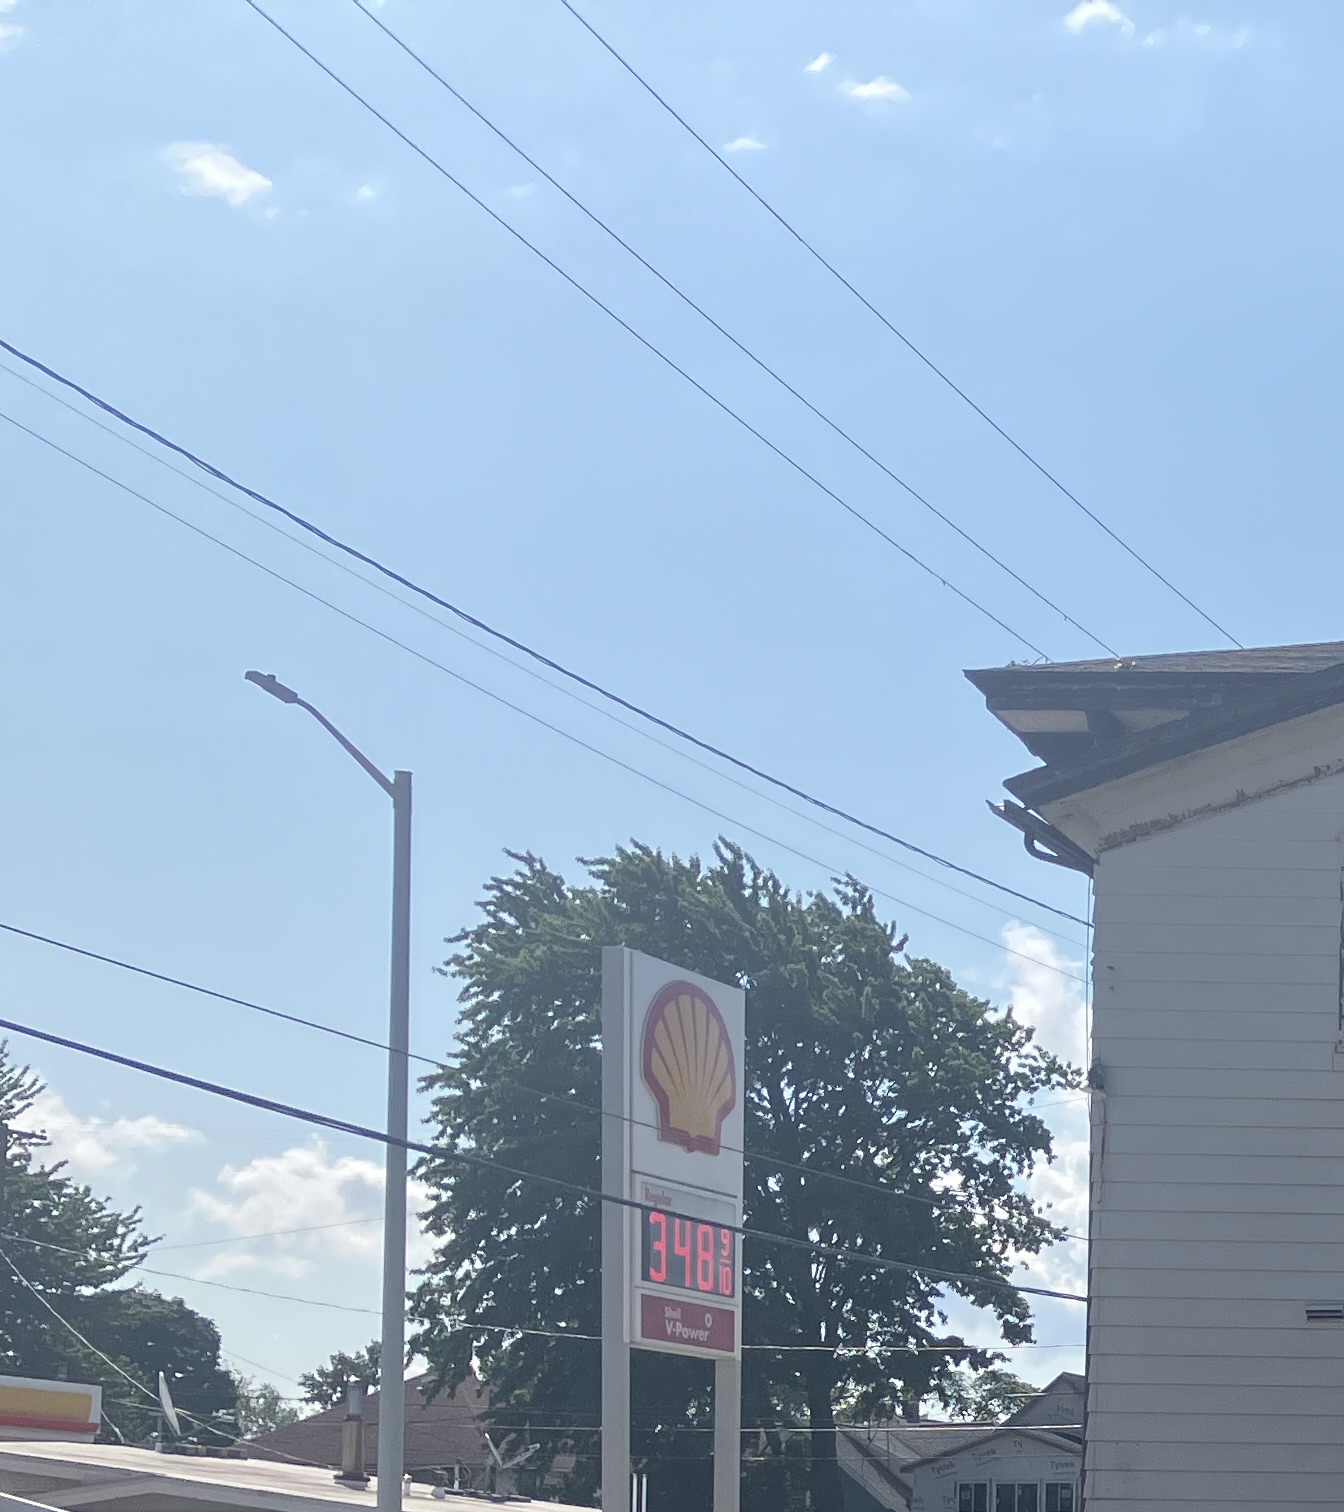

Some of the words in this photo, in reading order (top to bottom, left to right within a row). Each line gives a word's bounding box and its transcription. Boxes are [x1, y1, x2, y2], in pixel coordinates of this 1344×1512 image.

[648, 1211, 715, 1291] 348
[664, 1306, 682, 1320] Shell
[664, 1319, 709, 1341] V-Power
